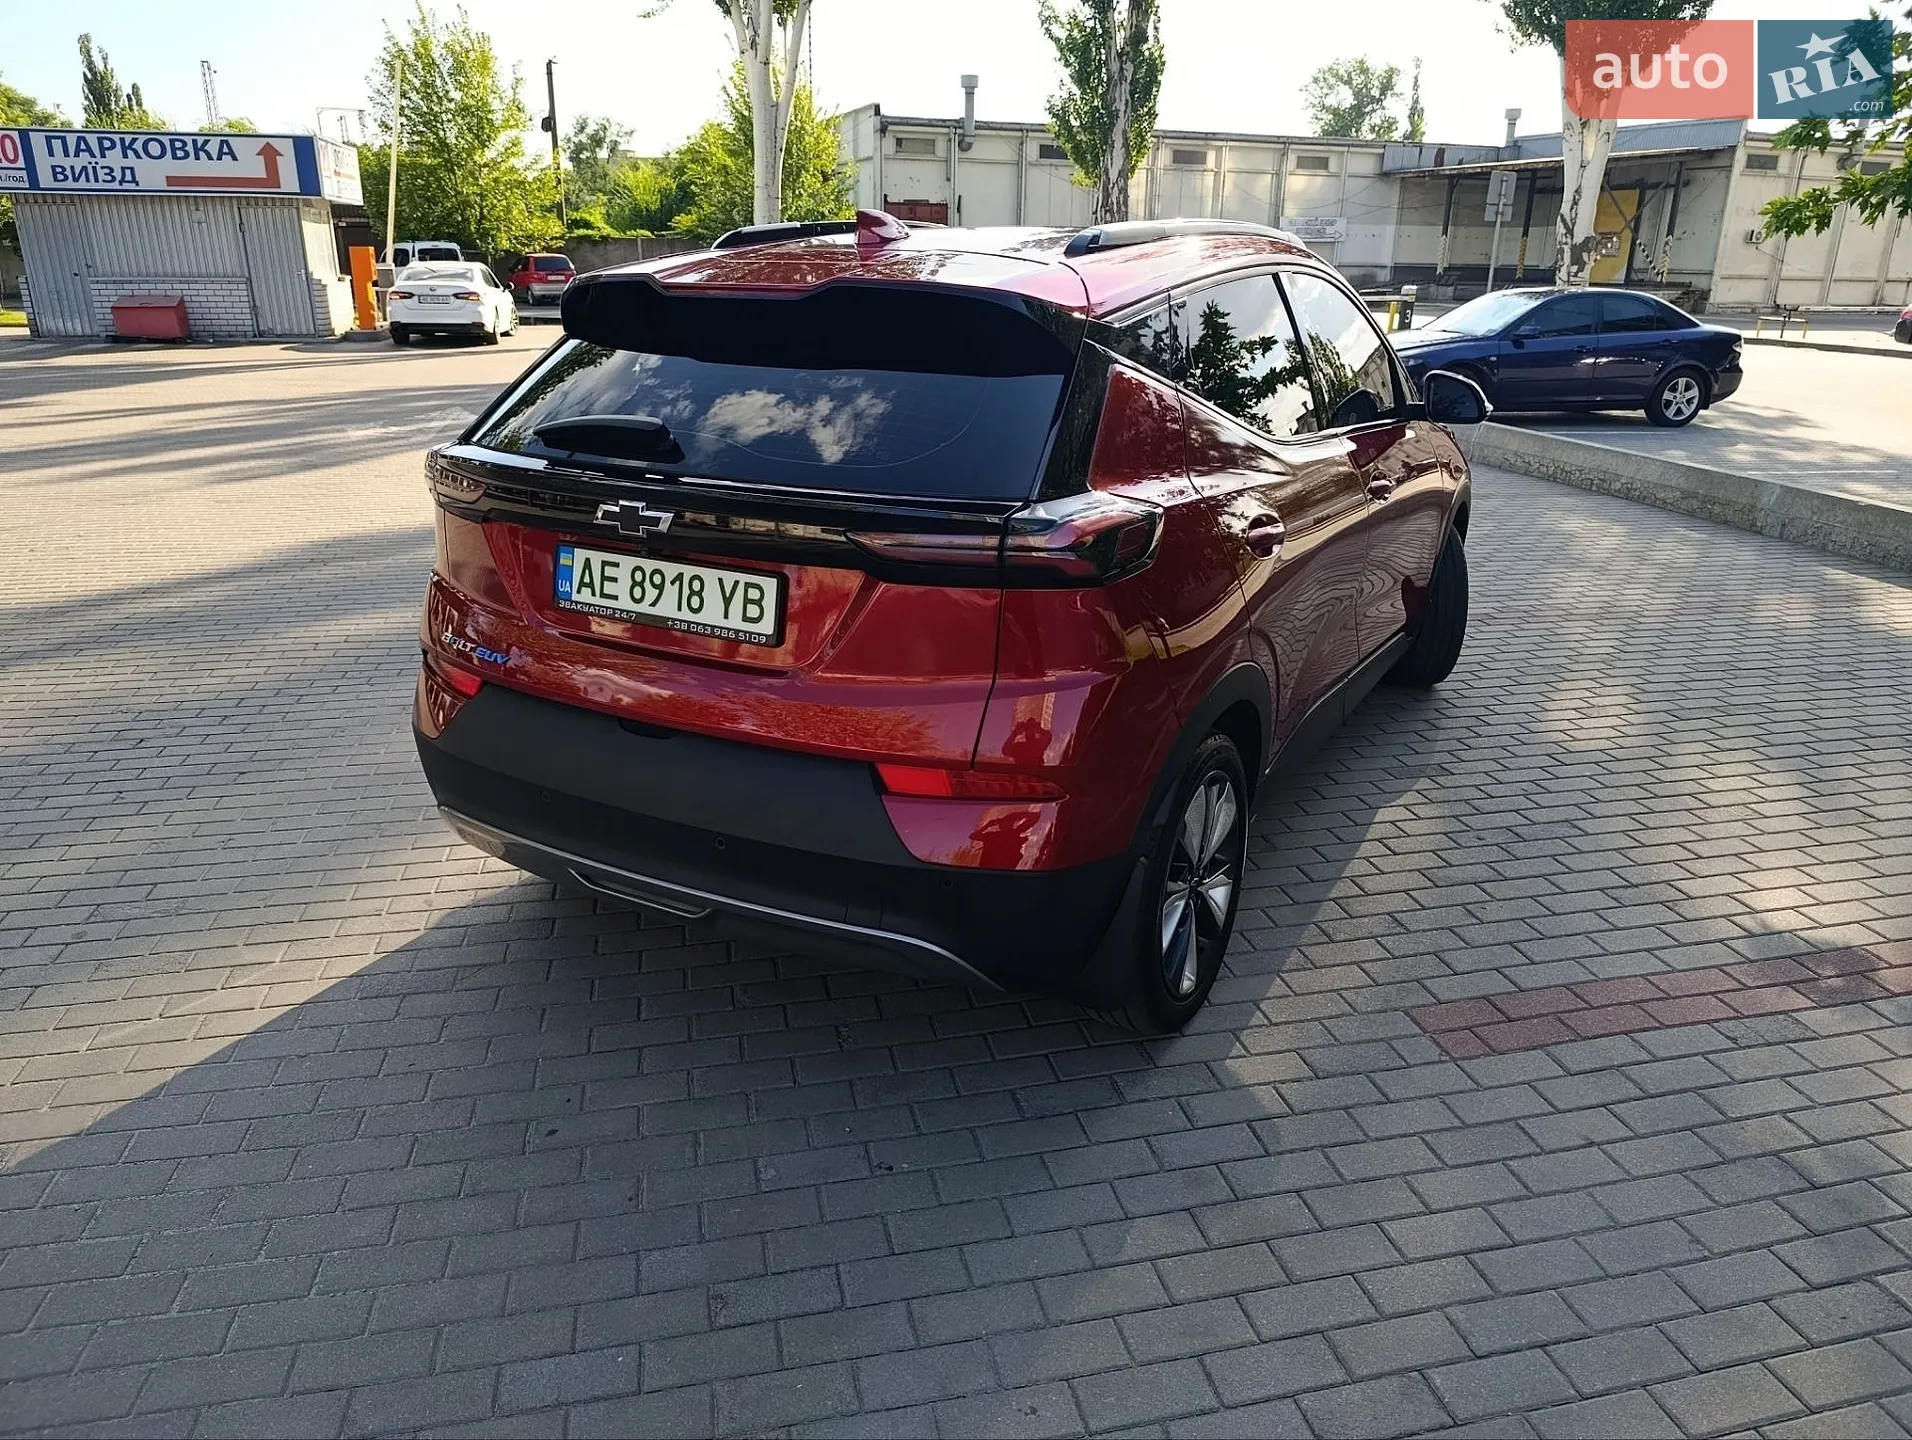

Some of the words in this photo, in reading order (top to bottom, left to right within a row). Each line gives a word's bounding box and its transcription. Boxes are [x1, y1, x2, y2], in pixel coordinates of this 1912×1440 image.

[44, 135, 239, 162] ПАРКОВКА
[50, 161, 140, 187] ВИЇЗД
[1404, 309, 1412, 323] 3
[558, 579, 572, 593] UA
[576, 557, 620, 602] AE
[629, 565, 705, 615] 8918
[717, 577, 766, 625] YB
[614, 609, 637, 621] 24/7
[690, 624, 711, 634] 063
[714, 628, 736, 638] 986
[738, 631, 767, 644] 5109
